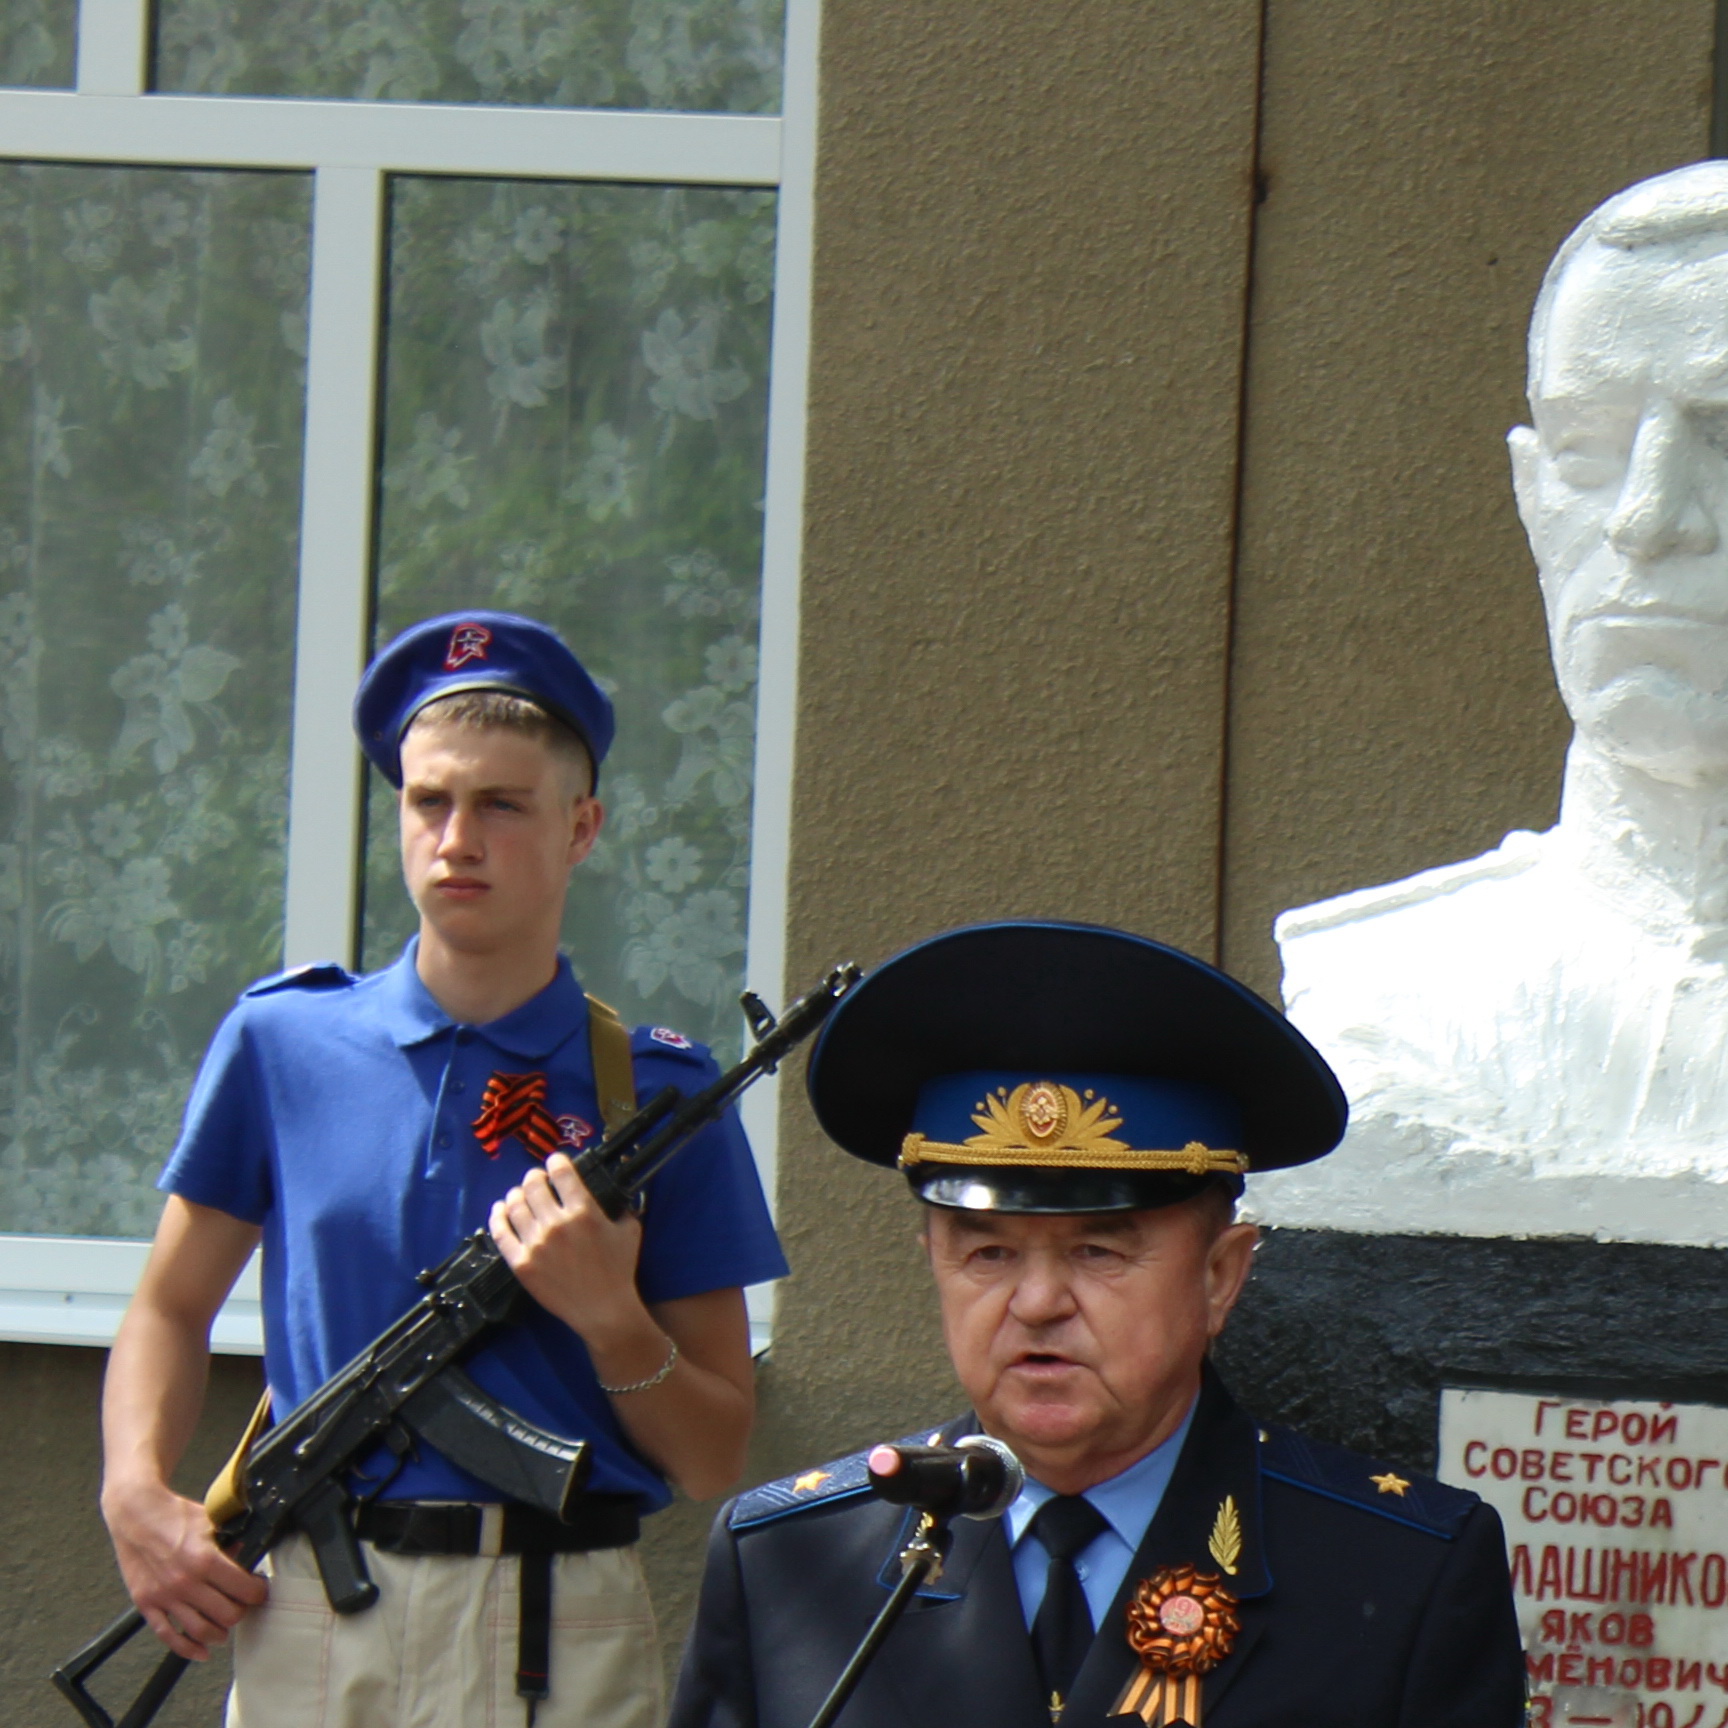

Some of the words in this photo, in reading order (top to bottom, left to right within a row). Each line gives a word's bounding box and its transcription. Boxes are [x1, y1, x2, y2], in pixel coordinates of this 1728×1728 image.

[1534, 1401, 1678, 1445] ГЕРОЙ
[1522, 1486, 1673, 1528] СОЮЗА
[1541, 1609, 1655, 1648] ЯКОВ
